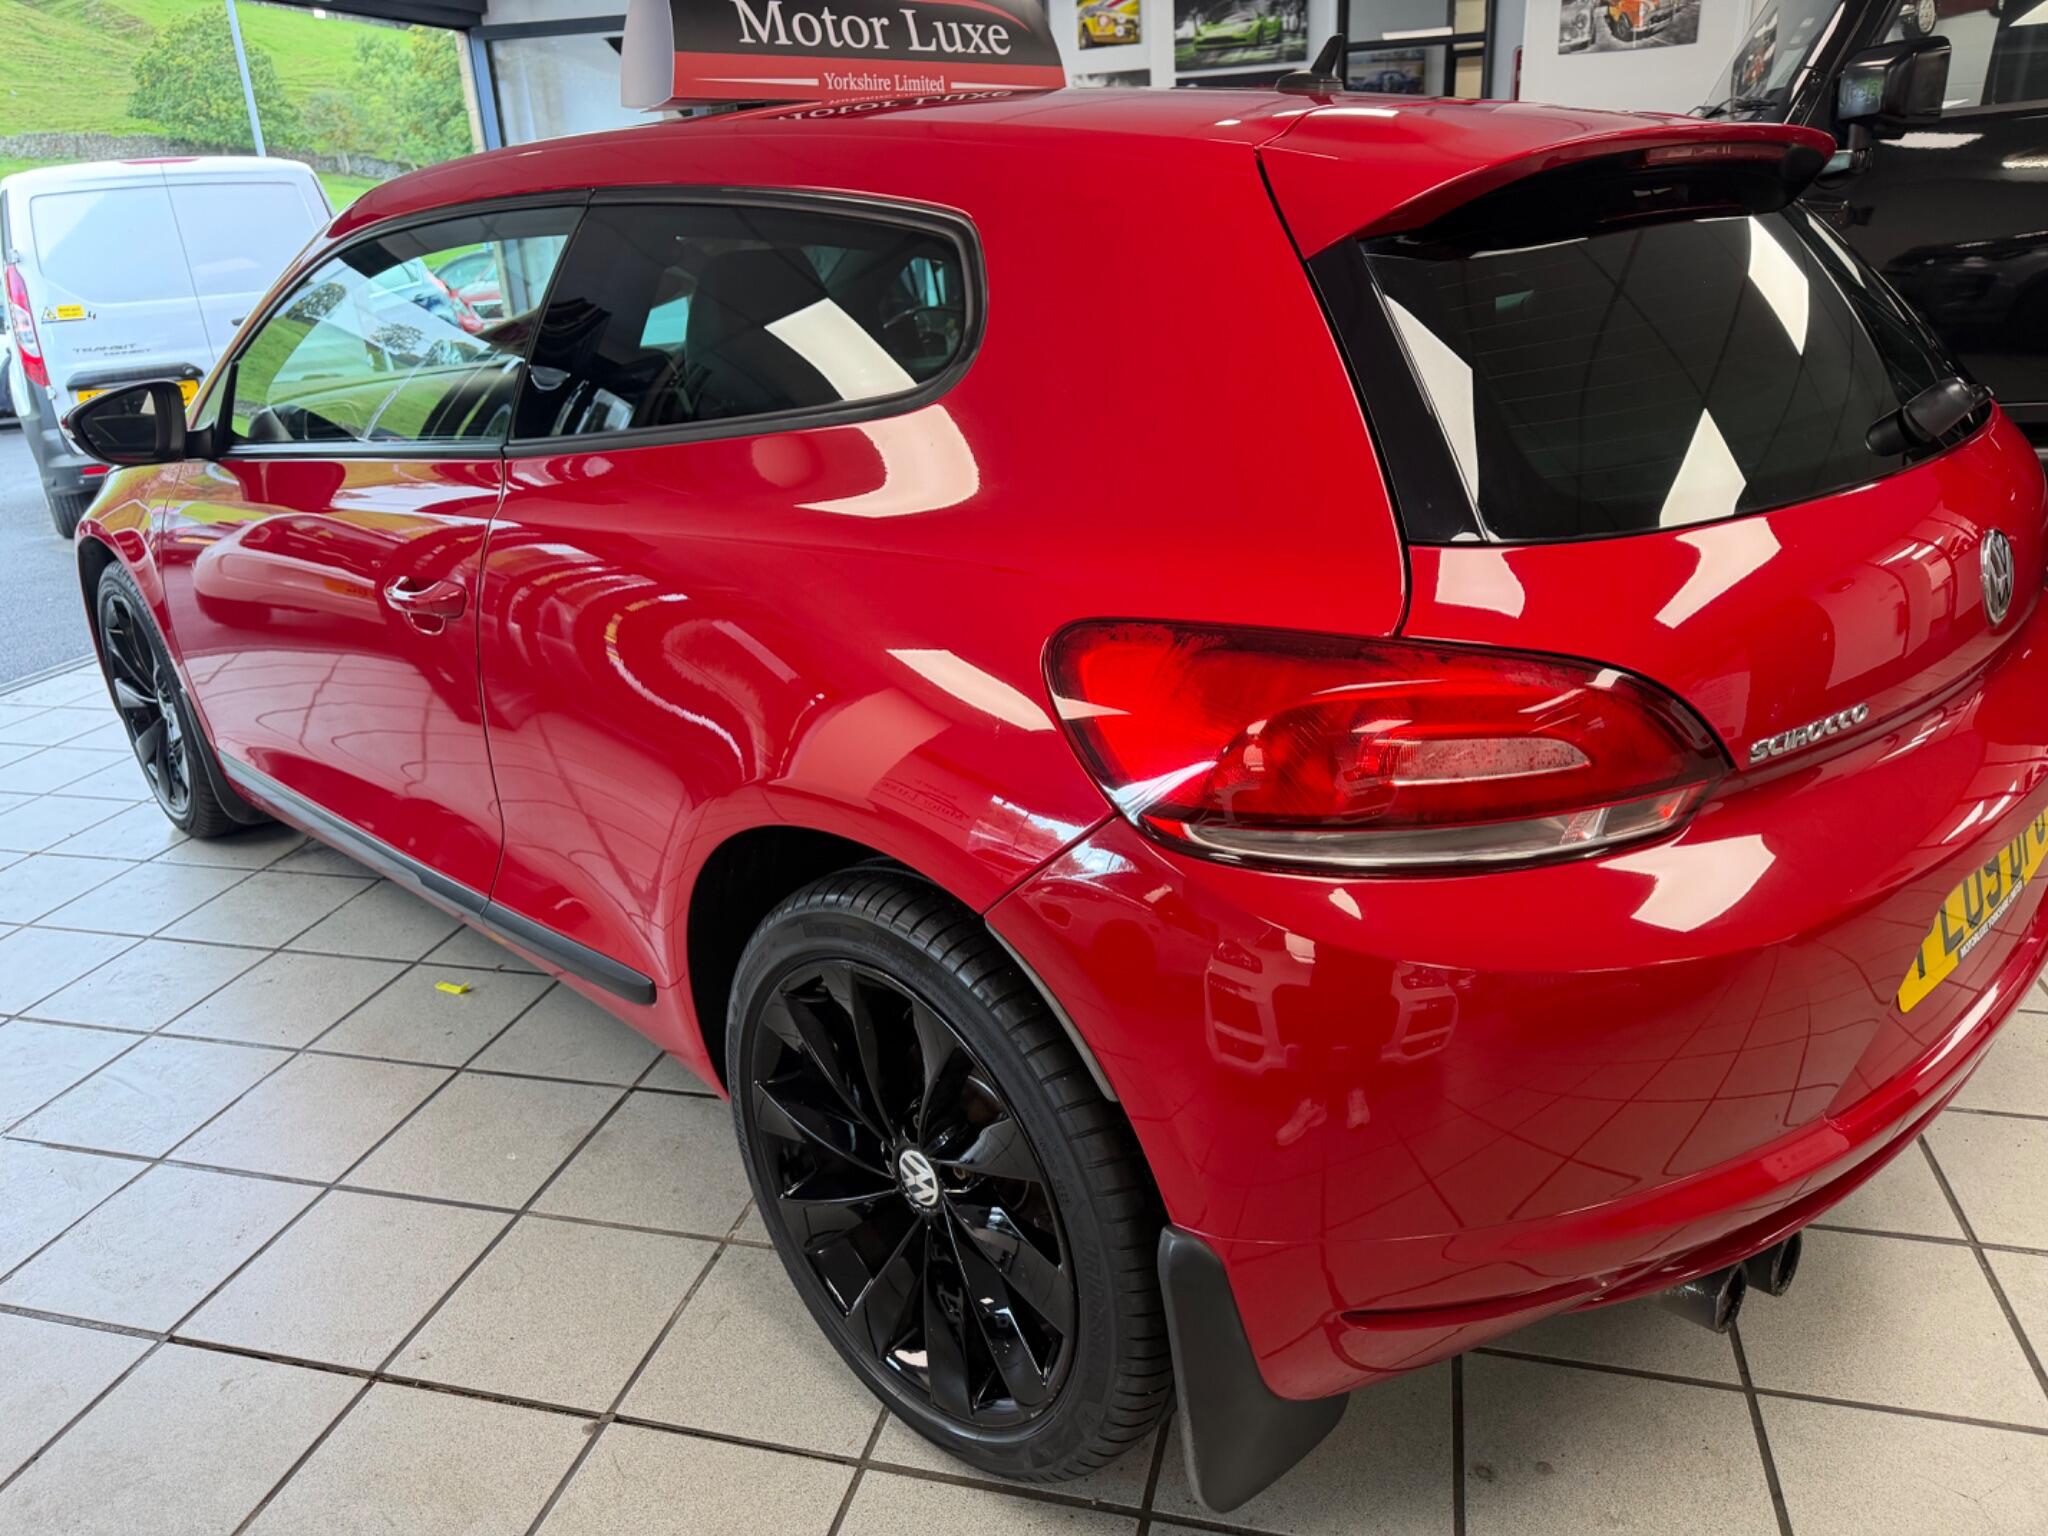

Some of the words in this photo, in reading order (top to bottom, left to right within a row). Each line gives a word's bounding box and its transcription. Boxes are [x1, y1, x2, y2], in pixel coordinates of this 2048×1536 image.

[730, 0, 890, 50] Motor
[899, 9, 1012, 55] Luxe
[823, 72, 891, 91] Yorkshire
[895, 74, 946, 93] Limited
[1750, 702, 1869, 763] SCIROCCO
